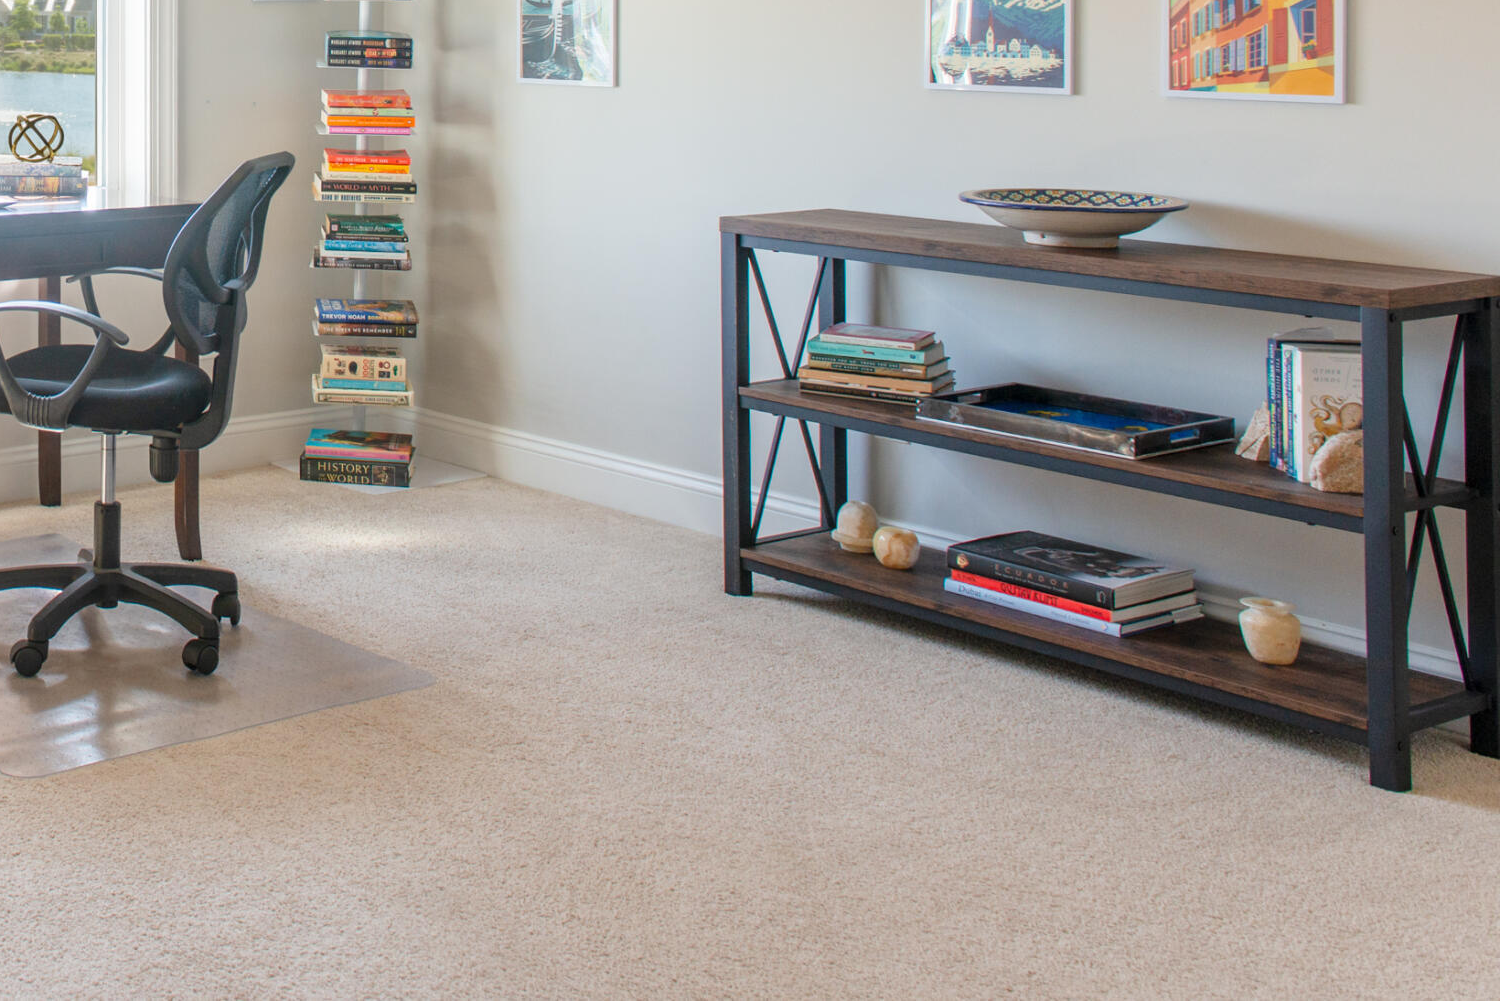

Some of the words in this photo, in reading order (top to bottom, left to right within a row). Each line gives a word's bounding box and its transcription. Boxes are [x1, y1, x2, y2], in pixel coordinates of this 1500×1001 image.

[317, 461, 370, 474] HISTORY
[327, 473, 370, 484] WORLD
[994, 563, 1069, 589] ECUADOR
[957, 584, 981, 598] Dubai
